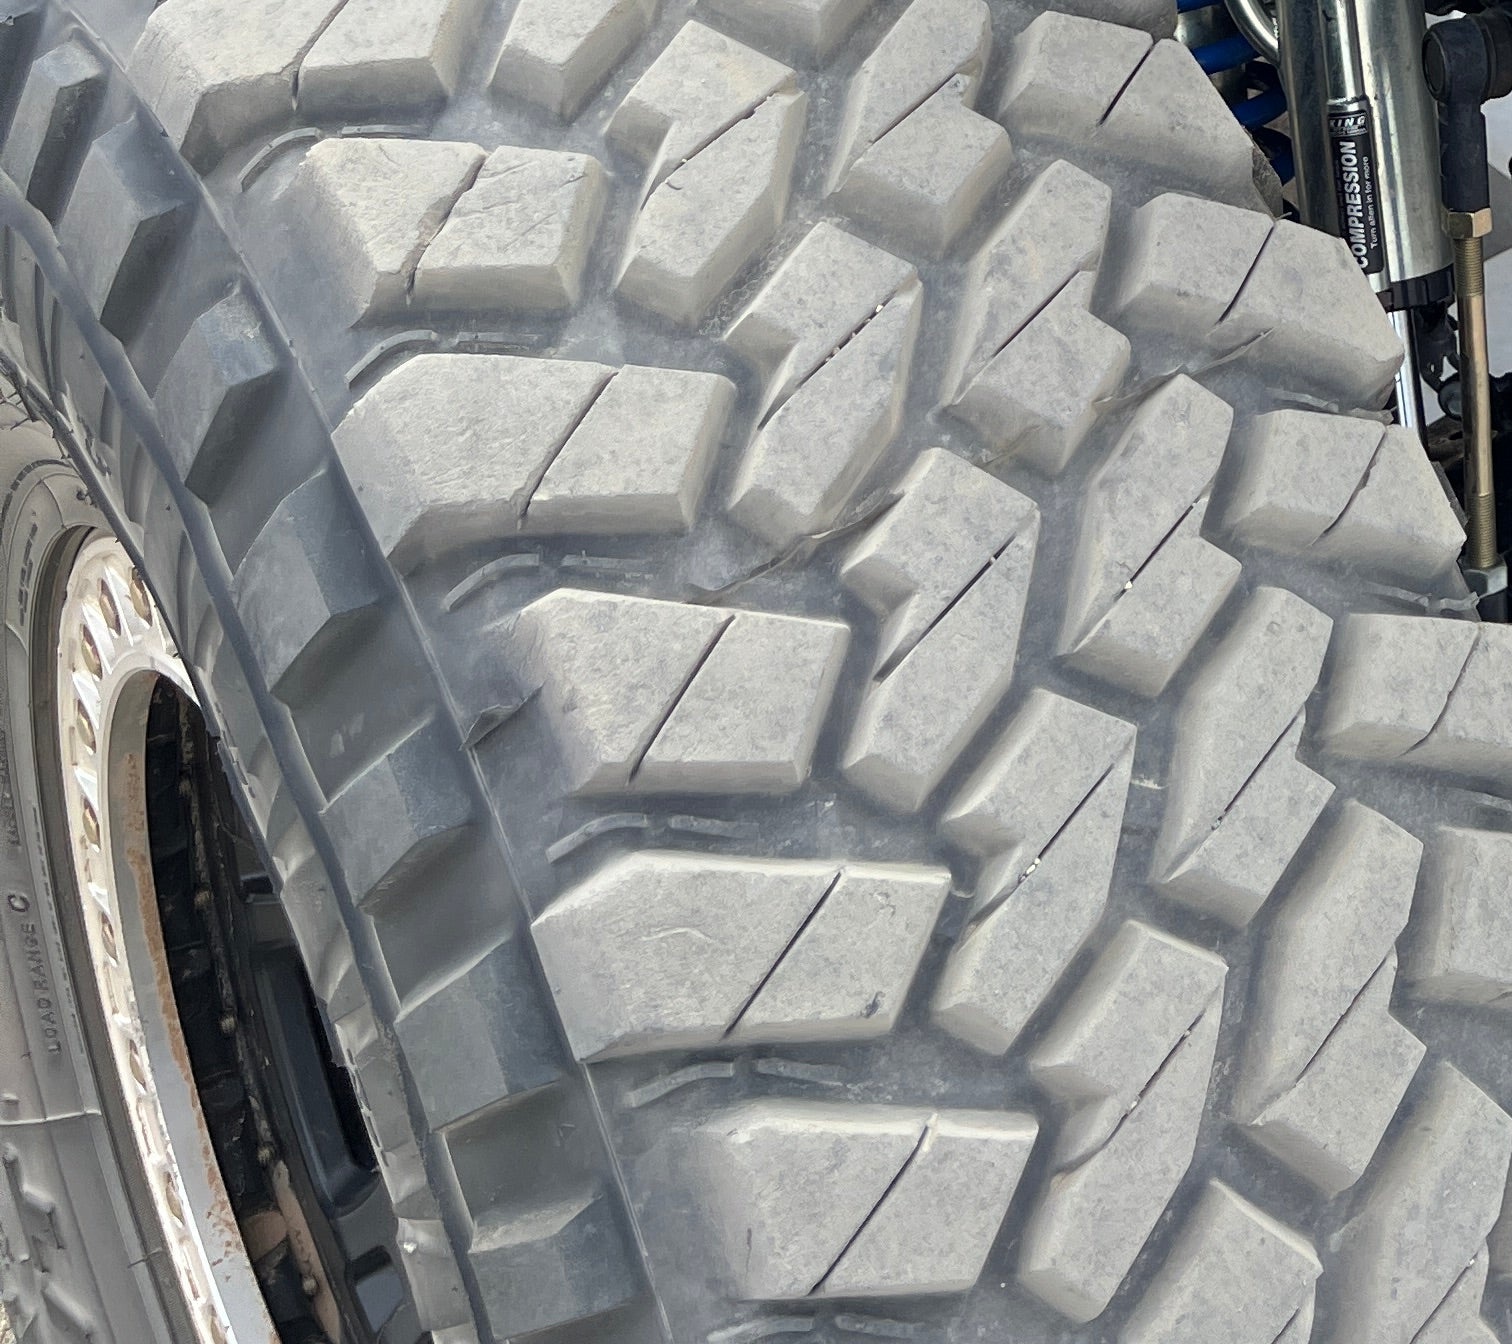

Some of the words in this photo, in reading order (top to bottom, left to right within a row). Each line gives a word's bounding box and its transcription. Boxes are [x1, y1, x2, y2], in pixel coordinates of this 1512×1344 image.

[1339, 141, 1369, 270] COMPRESSION
[21, 922, 49, 993] RANGE
[38, 998, 62, 1054] LOAD
